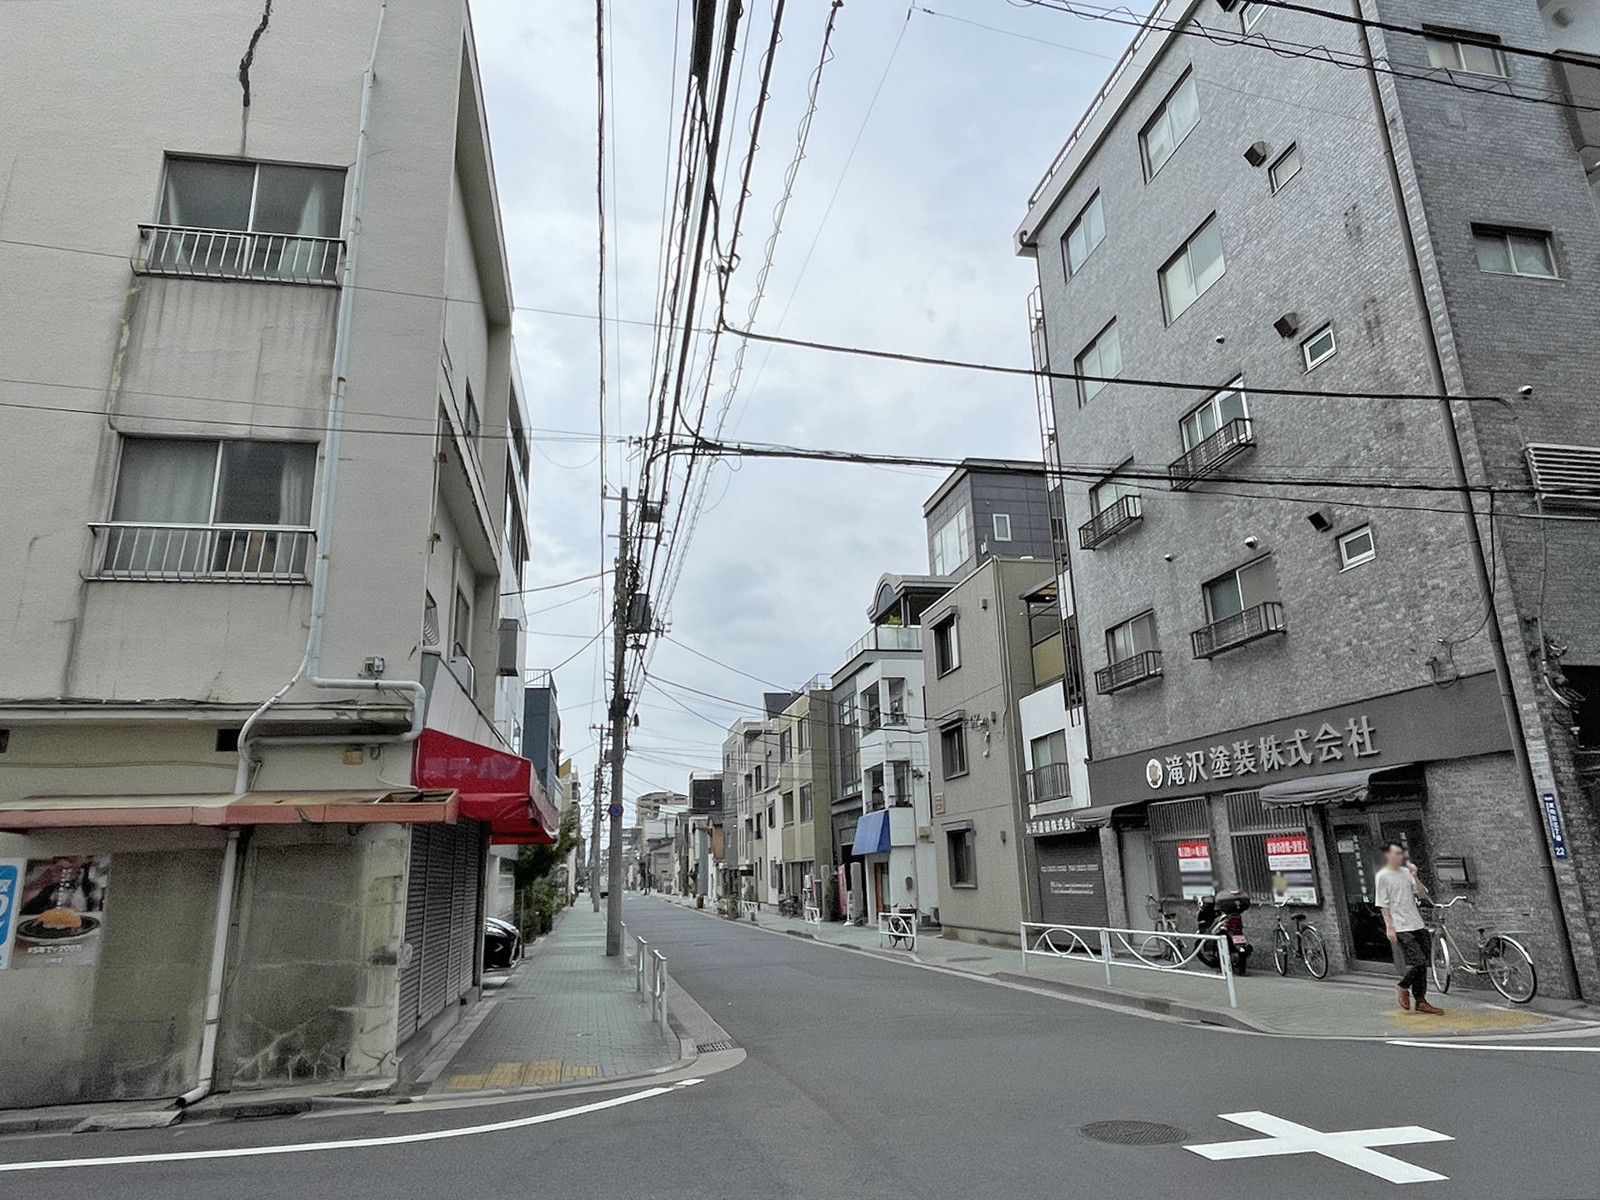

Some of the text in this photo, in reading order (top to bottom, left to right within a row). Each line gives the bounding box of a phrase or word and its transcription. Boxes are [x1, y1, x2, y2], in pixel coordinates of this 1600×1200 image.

[1165, 715, 1380, 786] 滝沢塗装株式会社
[1555, 846, 1565, 856] 22
